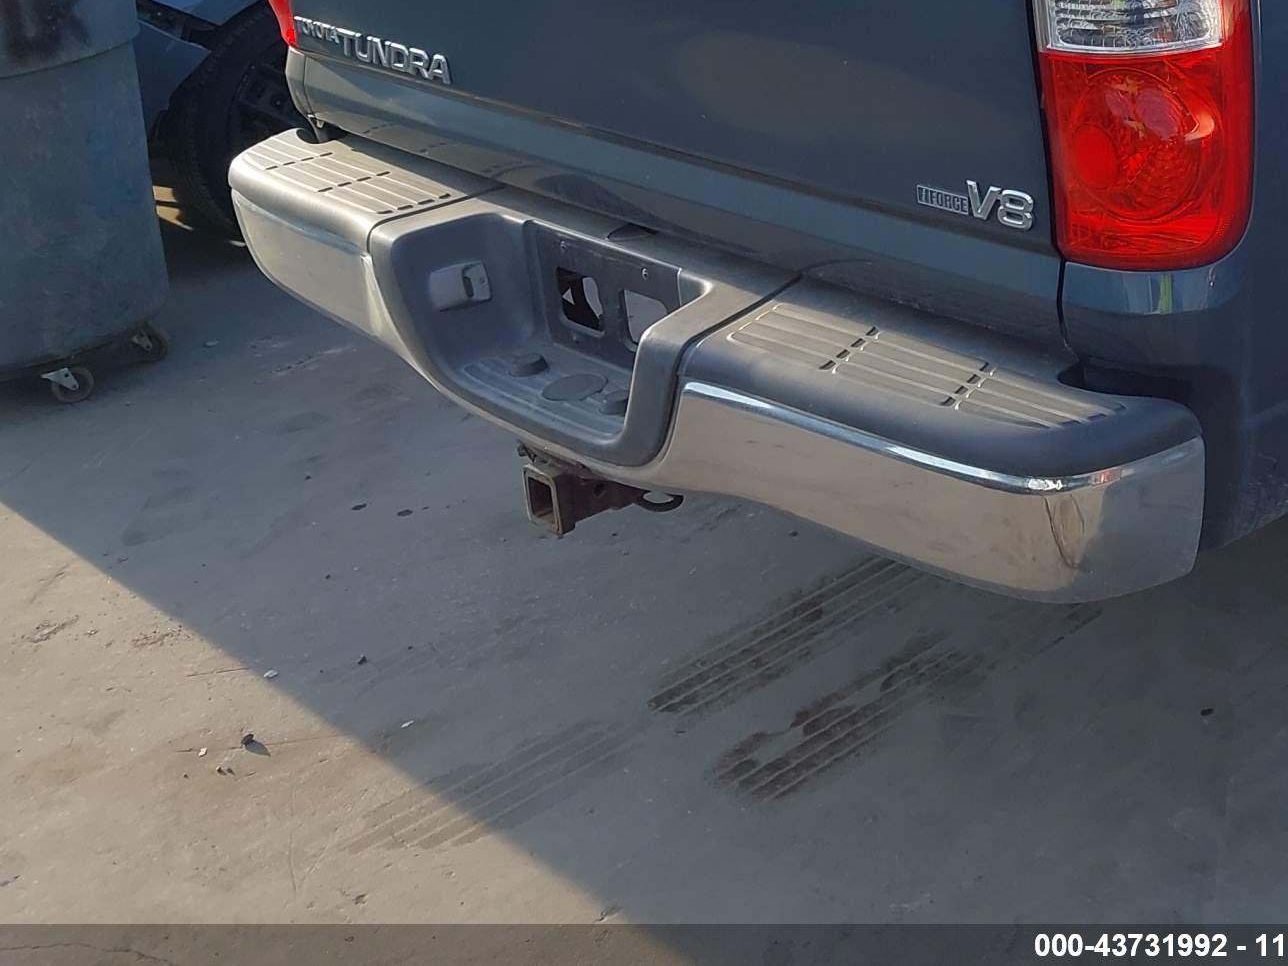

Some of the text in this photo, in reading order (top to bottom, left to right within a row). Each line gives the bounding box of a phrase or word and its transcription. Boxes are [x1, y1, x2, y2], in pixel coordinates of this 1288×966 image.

[294, 15, 452, 85] TOYOTA TUNDRA
[966, 179, 1036, 231] V8
